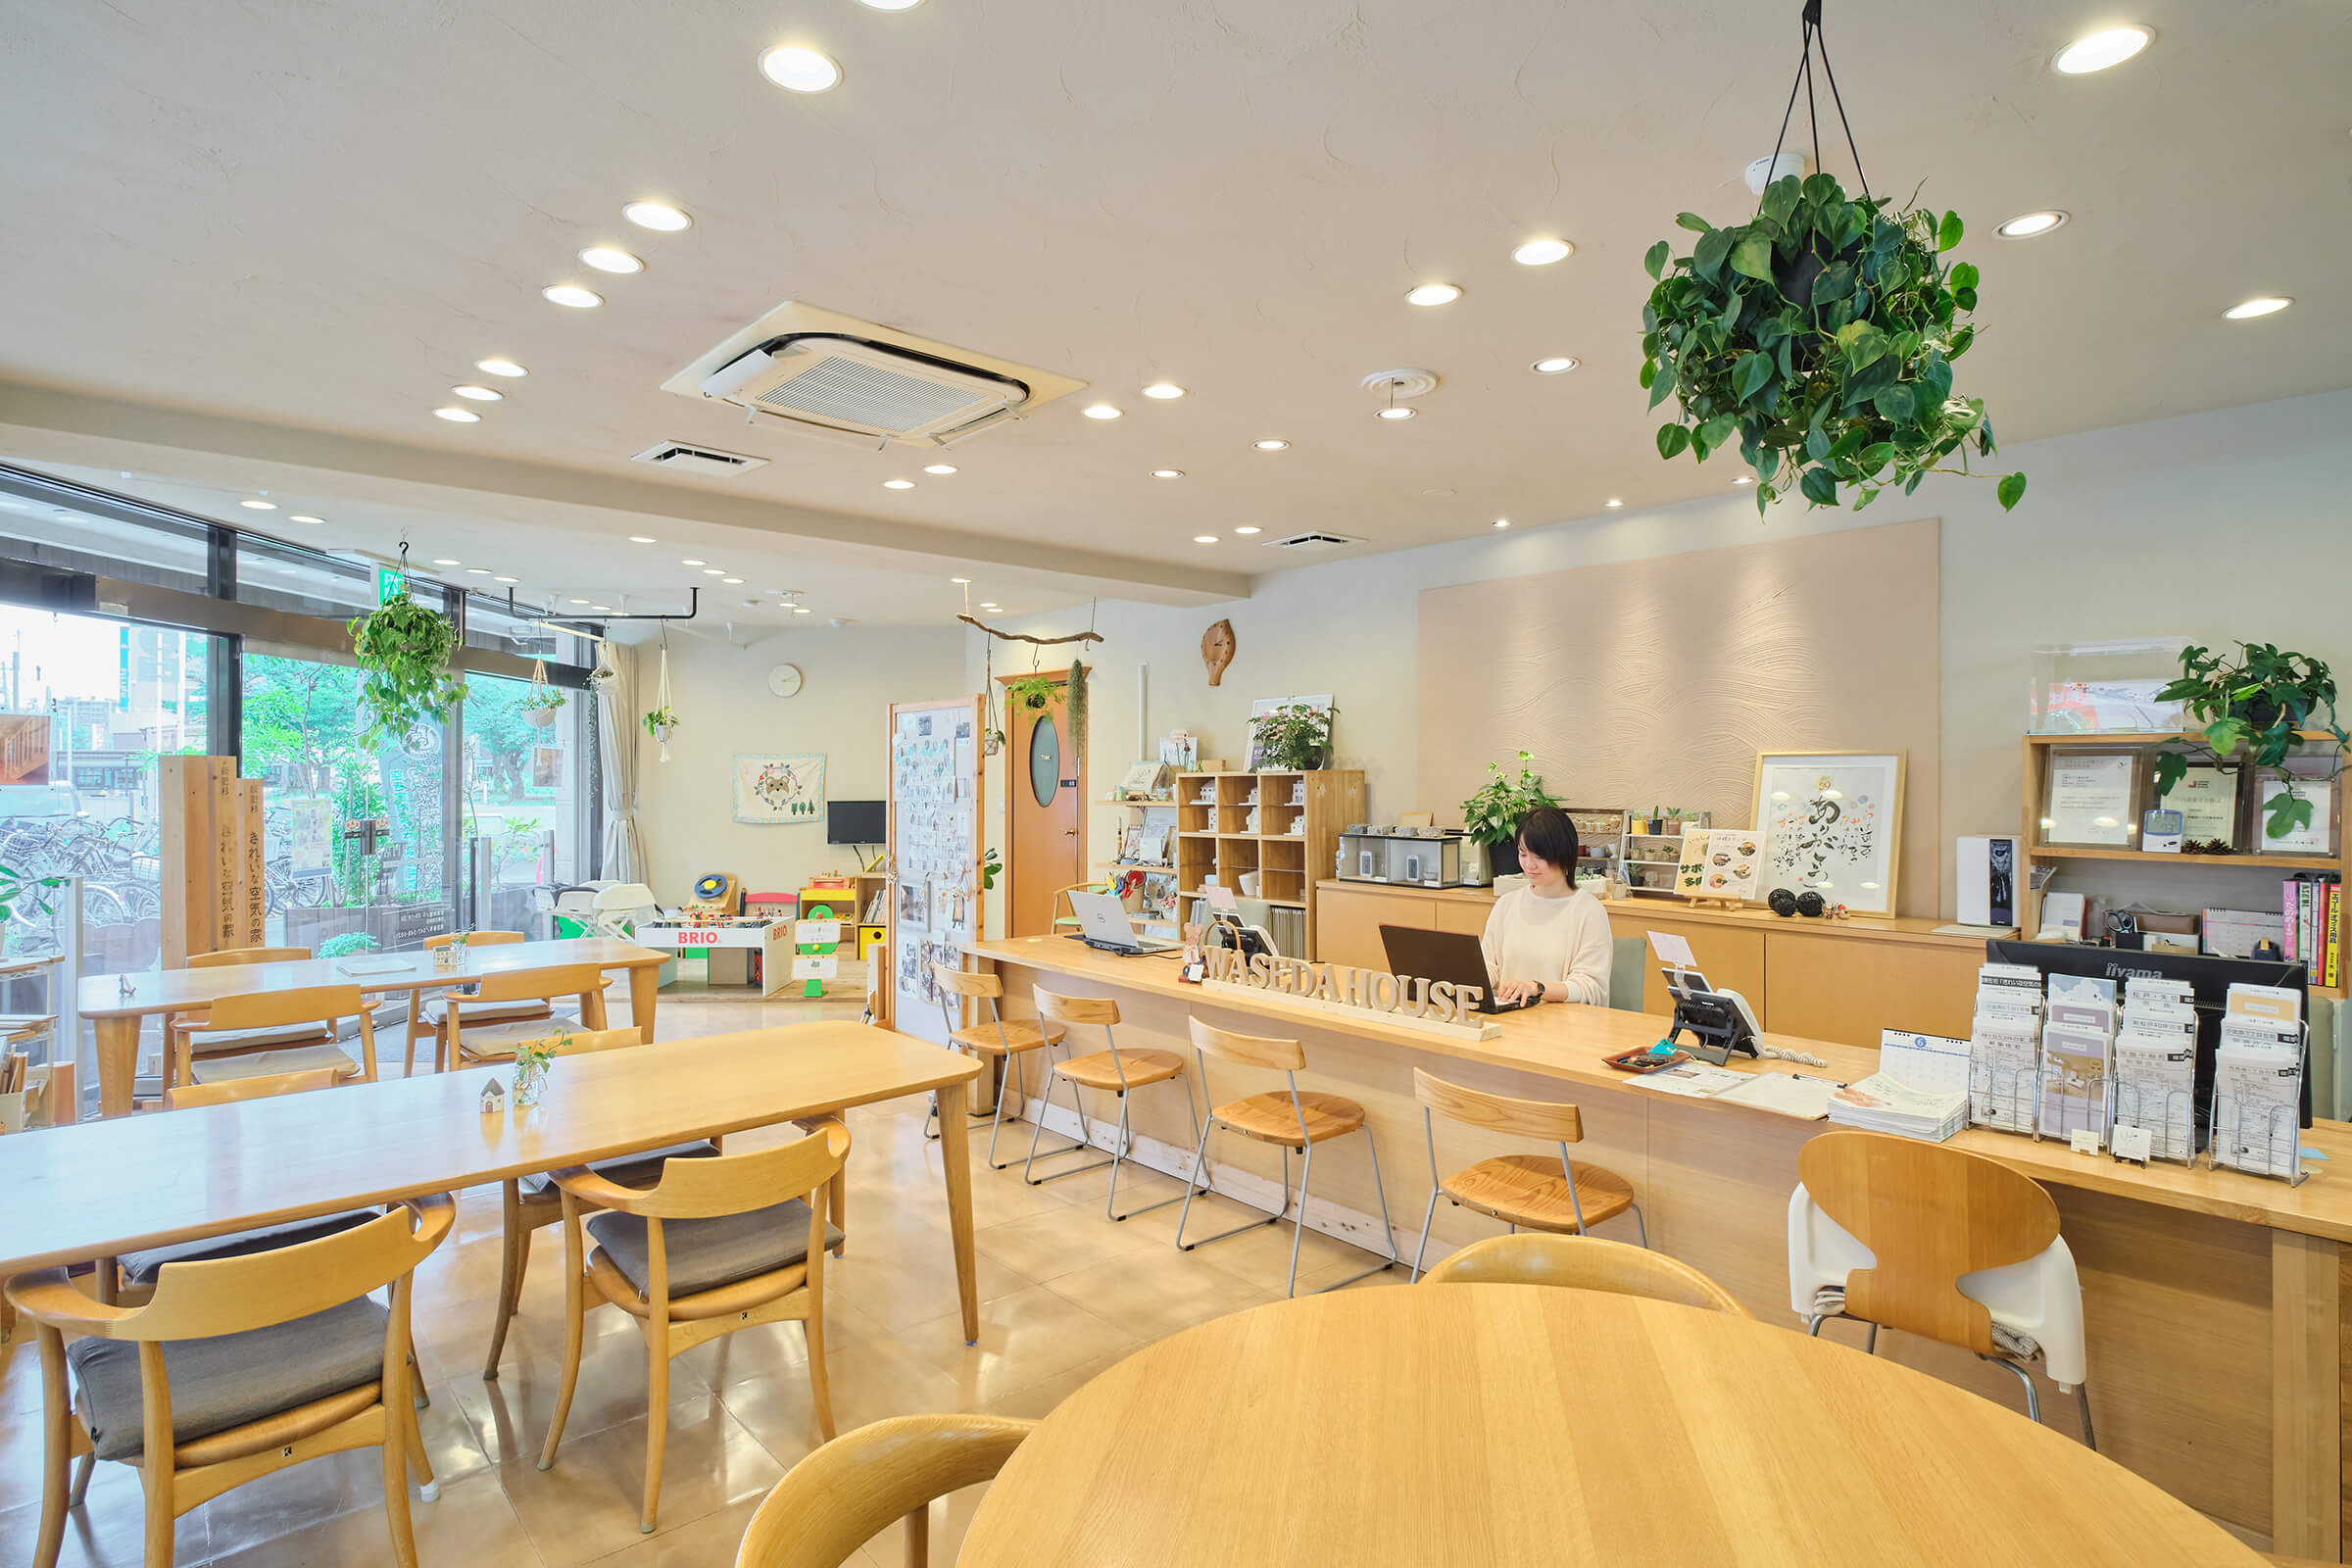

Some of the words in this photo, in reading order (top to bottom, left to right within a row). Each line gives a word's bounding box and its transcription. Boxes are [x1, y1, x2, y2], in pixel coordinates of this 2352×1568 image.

[678, 932, 717, 944] BRIO
[772, 925, 788, 941] BRIO
[2105, 962, 2163, 980] iiyama
[1344, 965, 1484, 1029] HOUSE
